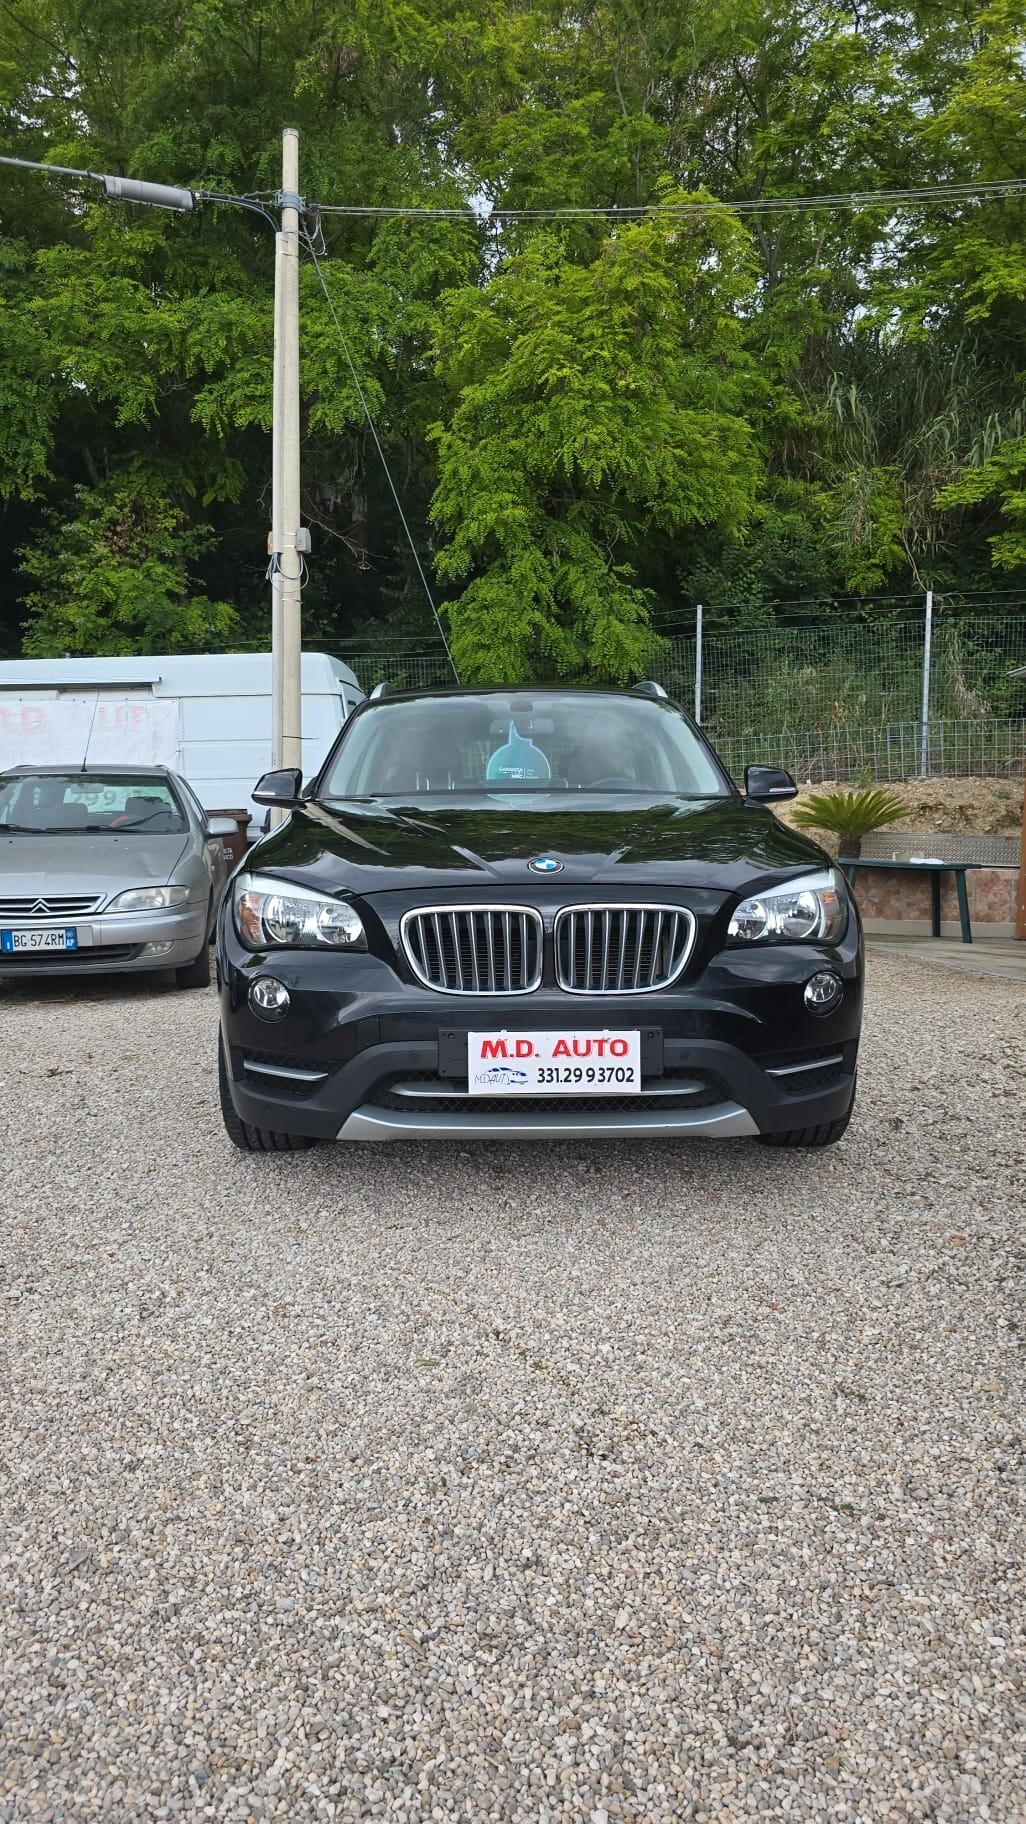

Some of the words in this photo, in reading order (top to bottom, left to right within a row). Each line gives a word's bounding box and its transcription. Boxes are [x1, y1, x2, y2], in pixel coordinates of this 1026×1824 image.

[14, 935, 27, 947] BG
[30, 933, 65, 947] 574RM
[480, 1039, 540, 1059] M.D.
[551, 1038, 630, 1058] AUTO
